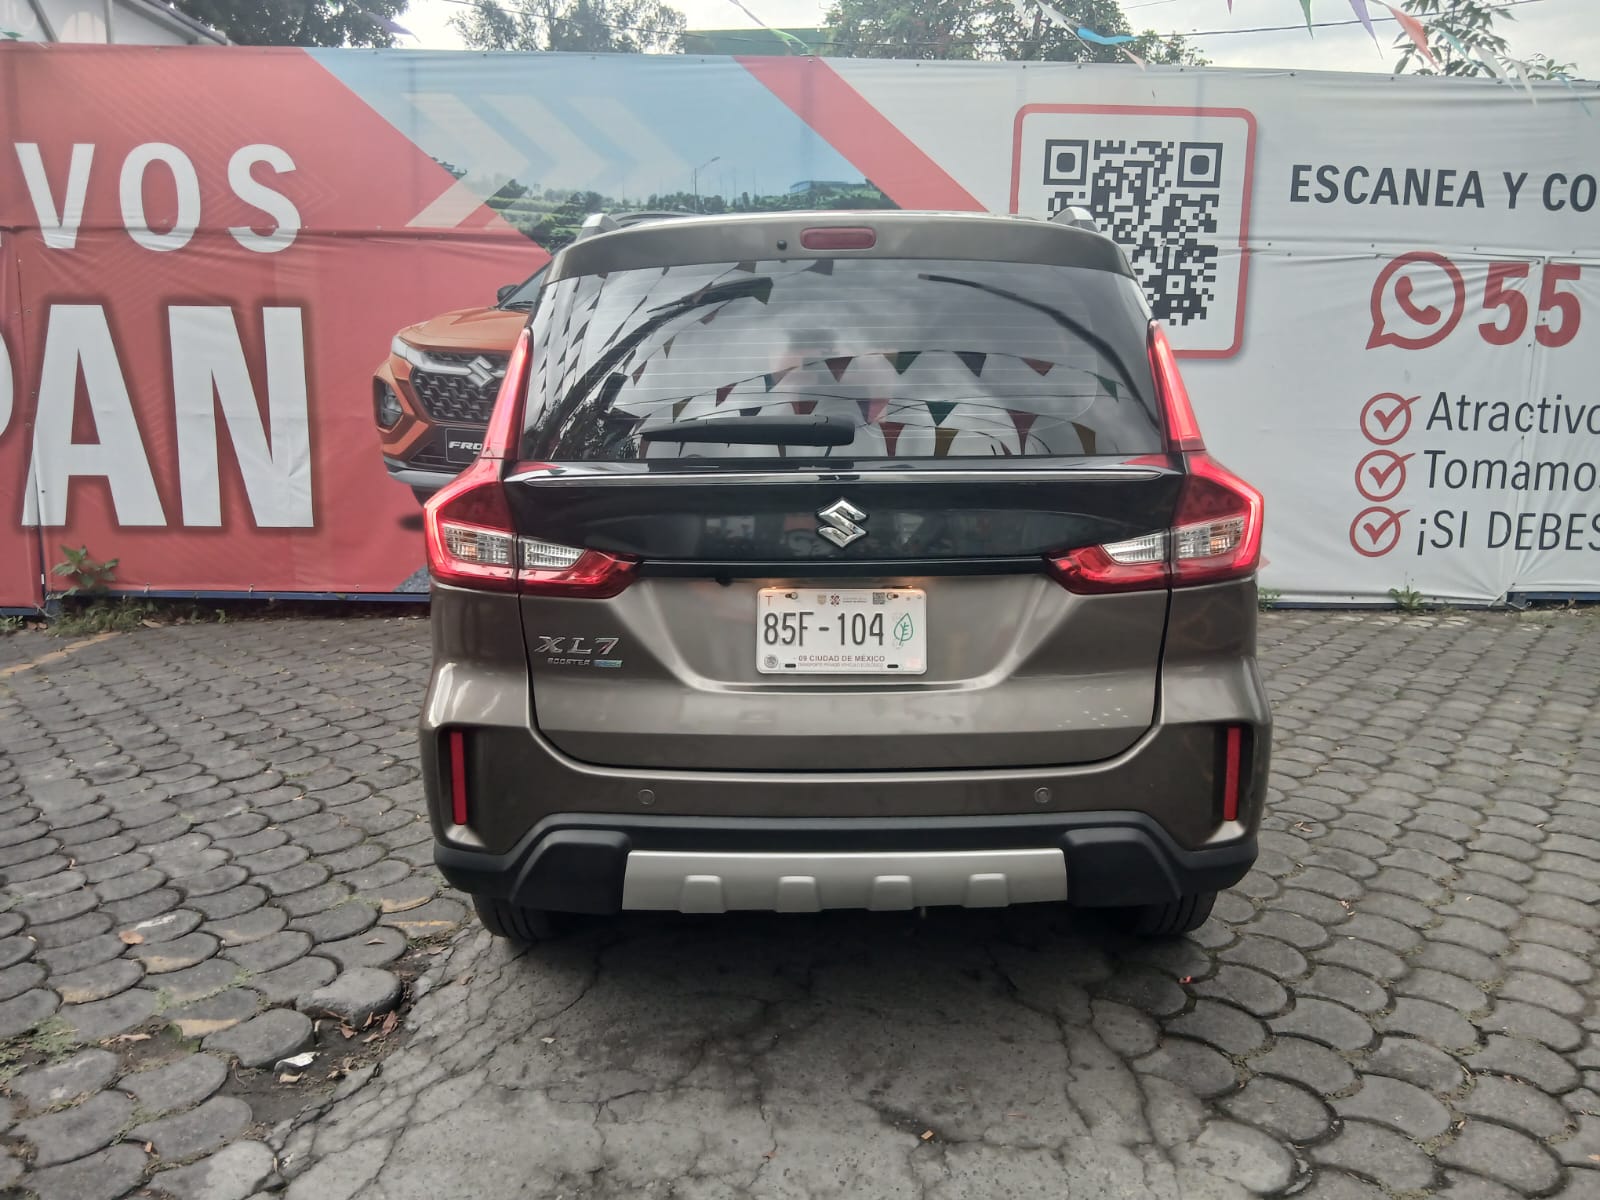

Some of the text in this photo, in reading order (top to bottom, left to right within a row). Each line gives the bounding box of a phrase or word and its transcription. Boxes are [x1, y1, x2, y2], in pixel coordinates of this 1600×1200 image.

[0, 142, 301, 253] VOS
[1290, 164, 1598, 213] ESCANEA Y CO
[1478, 261, 1582, 349] 55
[1423, 449, 1600, 492] Tomamo
[1417, 509, 1468, 556] ¡SI
[534, 635, 620, 655] XL7
[764, 611, 884, 647] 85F-104
